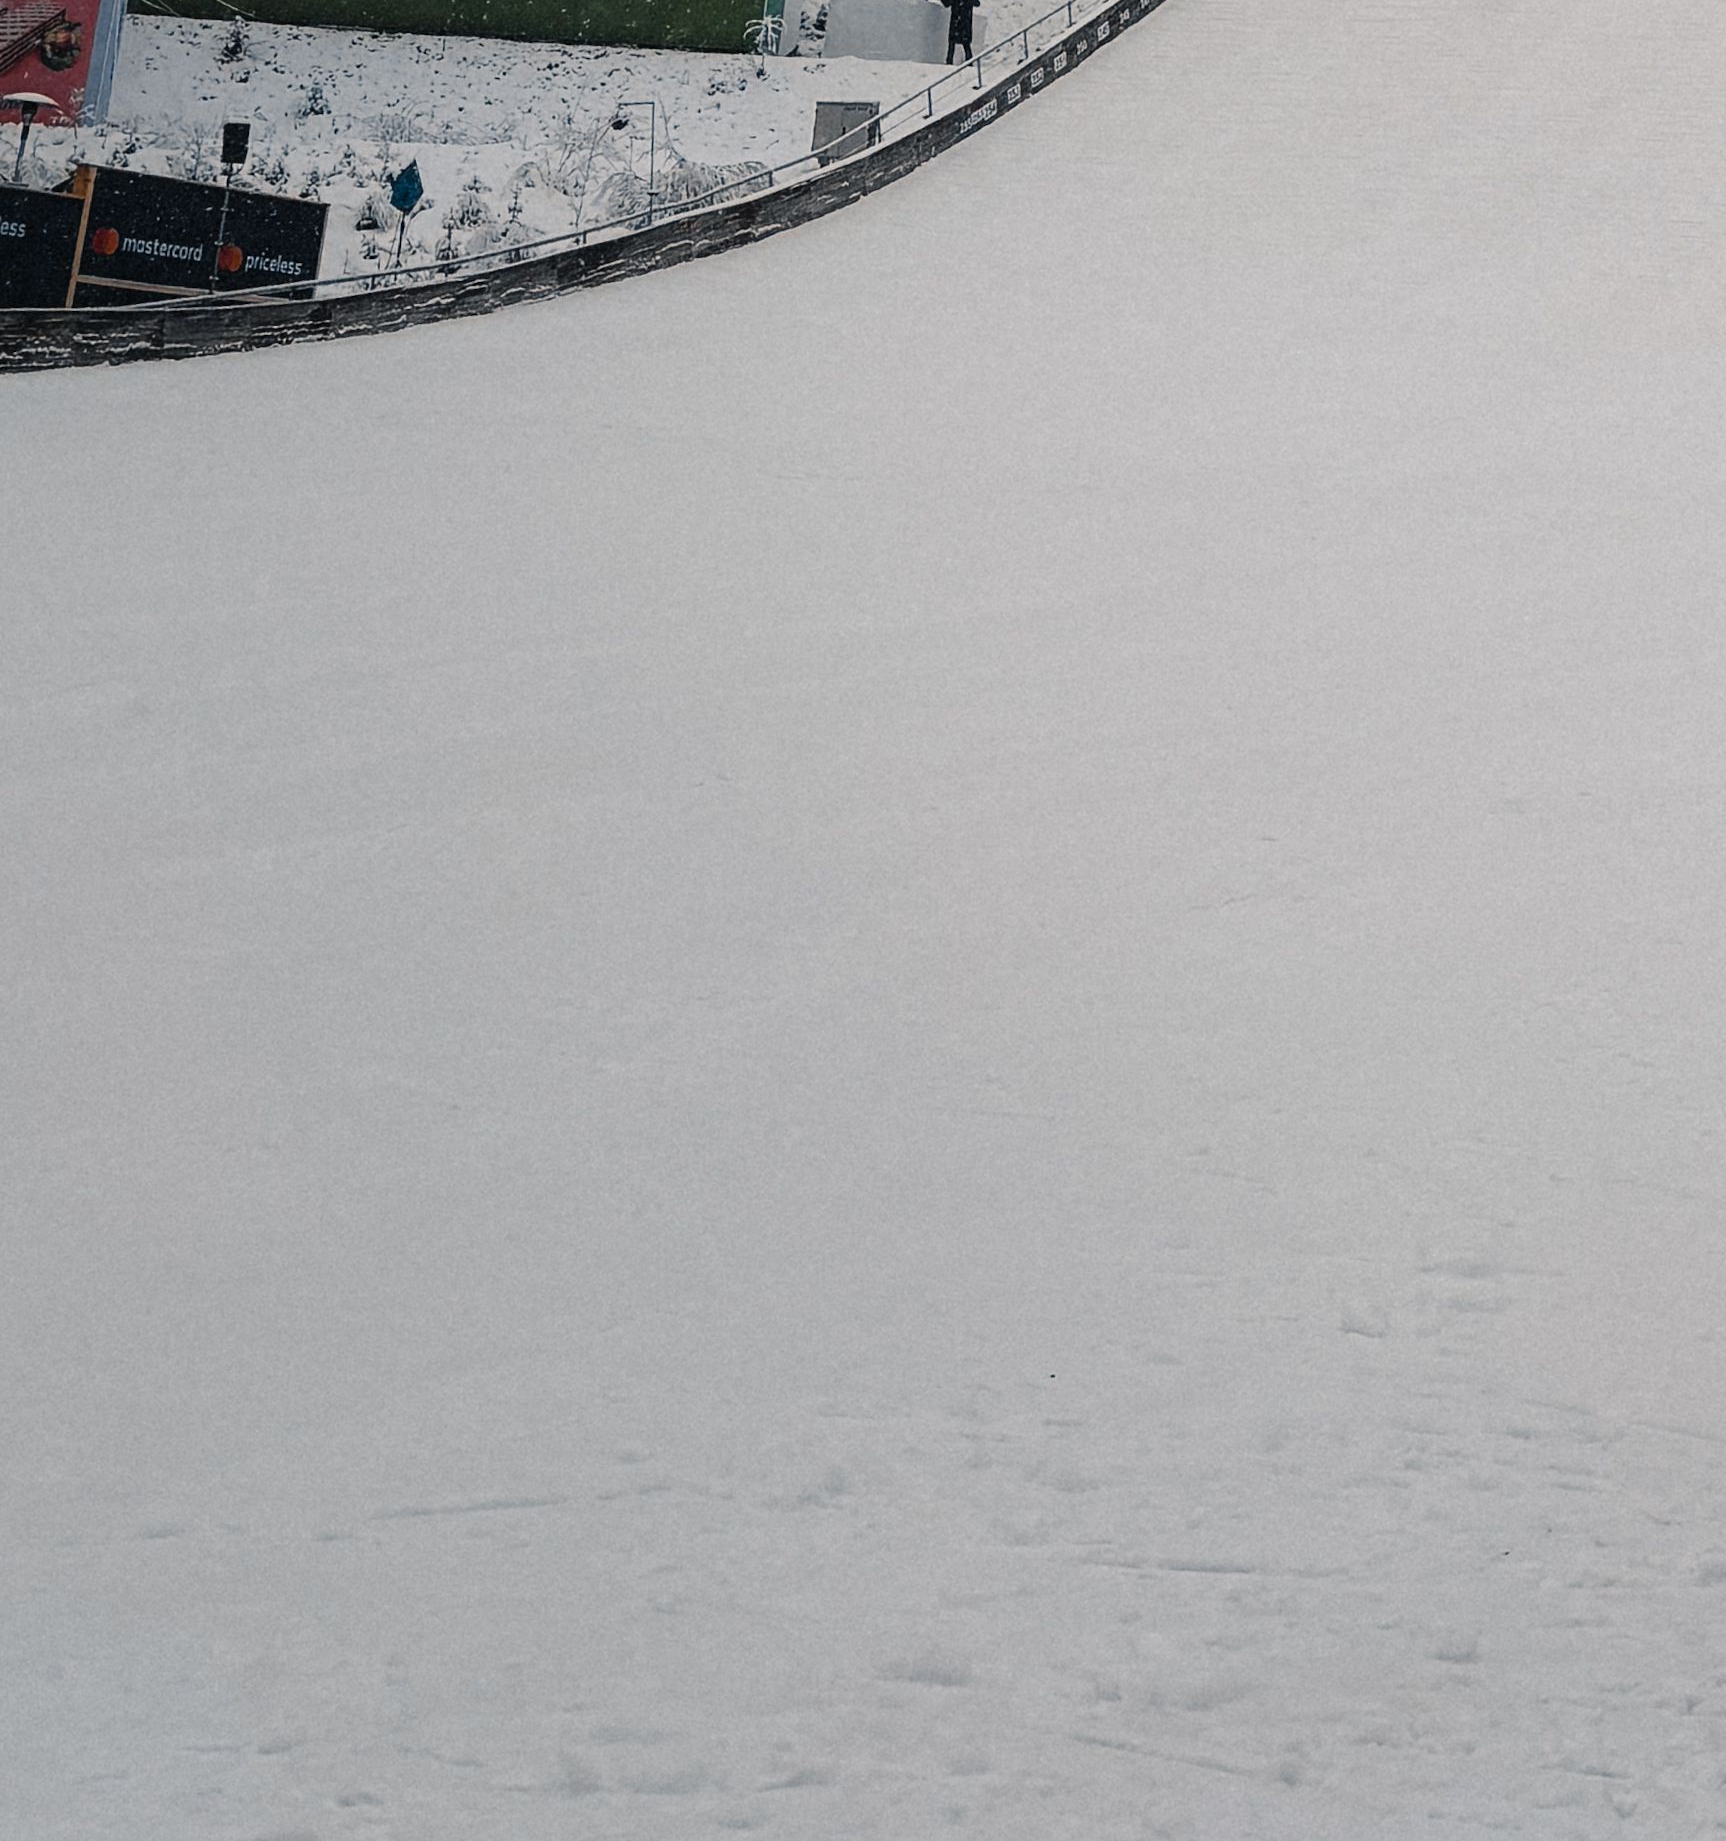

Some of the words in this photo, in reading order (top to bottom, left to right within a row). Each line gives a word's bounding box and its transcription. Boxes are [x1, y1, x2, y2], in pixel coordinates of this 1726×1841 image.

[0, 221, 26, 239] ess
[121, 236, 204, 262] mastercard
[244, 253, 303, 275] priceless
